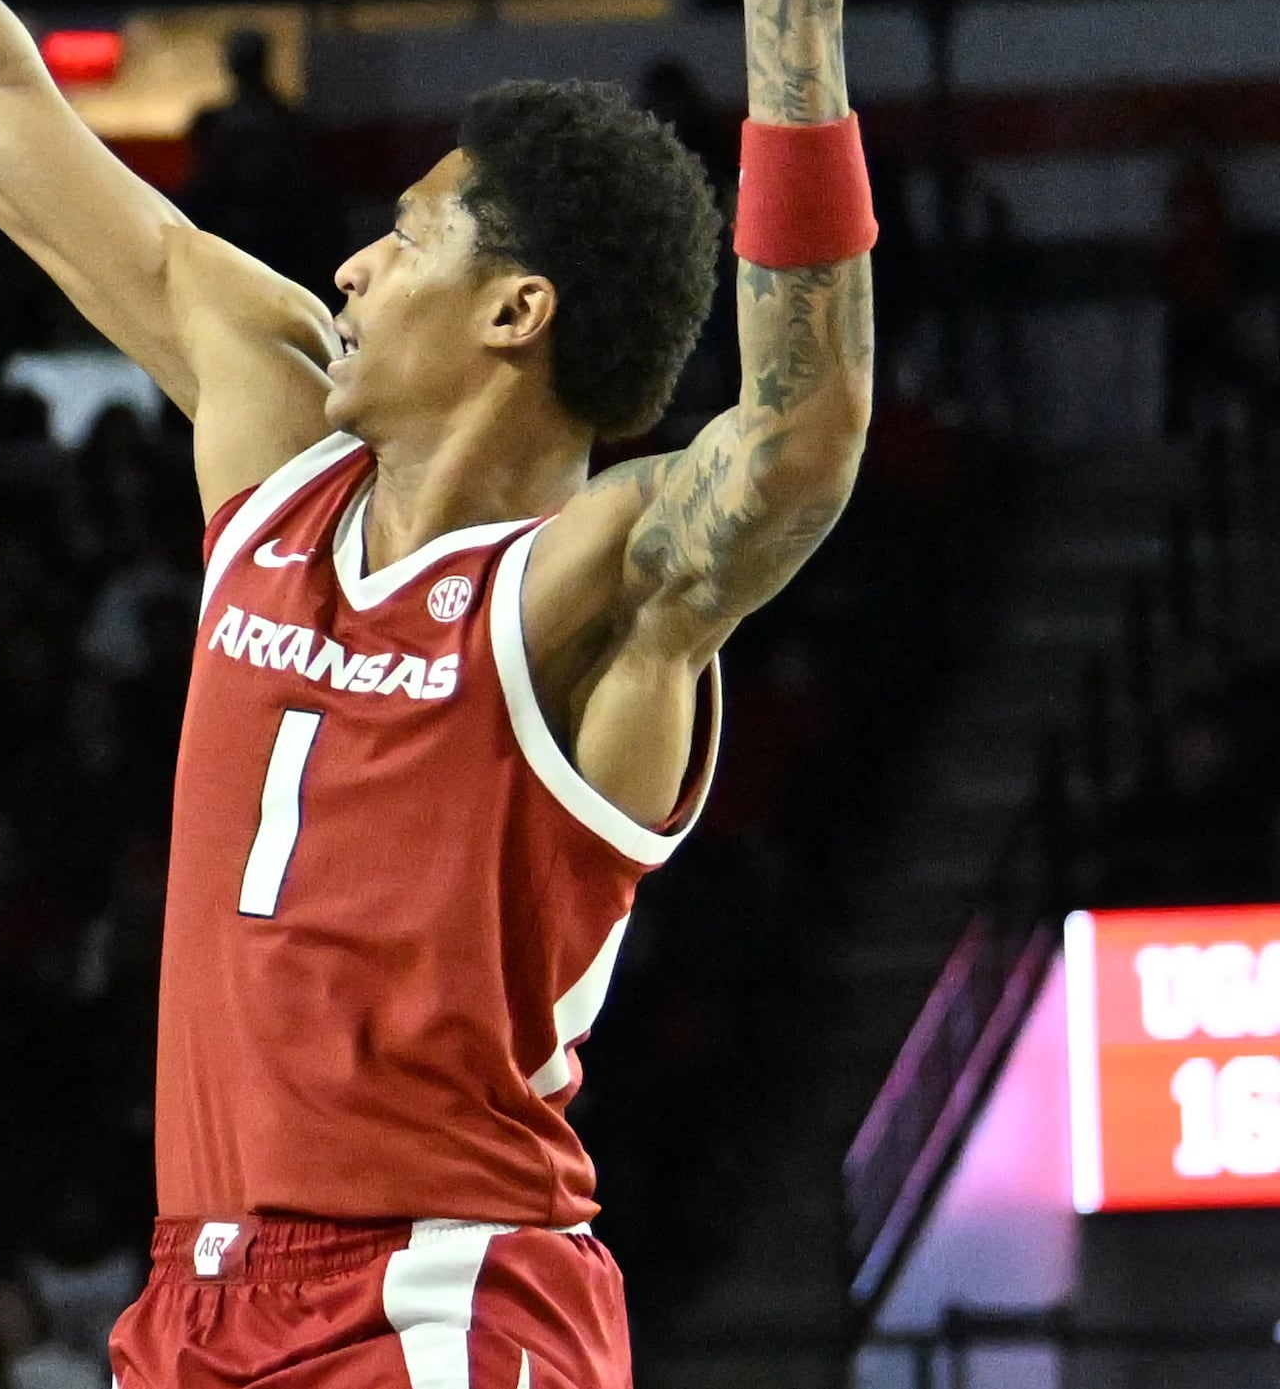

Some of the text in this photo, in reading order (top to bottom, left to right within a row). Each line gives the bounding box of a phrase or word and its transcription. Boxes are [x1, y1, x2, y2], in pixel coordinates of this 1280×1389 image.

[431, 579, 469, 619] SEC
[208, 604, 461, 701] ARKANSAS
[237, 707, 324, 920] 1
[198, 1236, 225, 1257] AR
